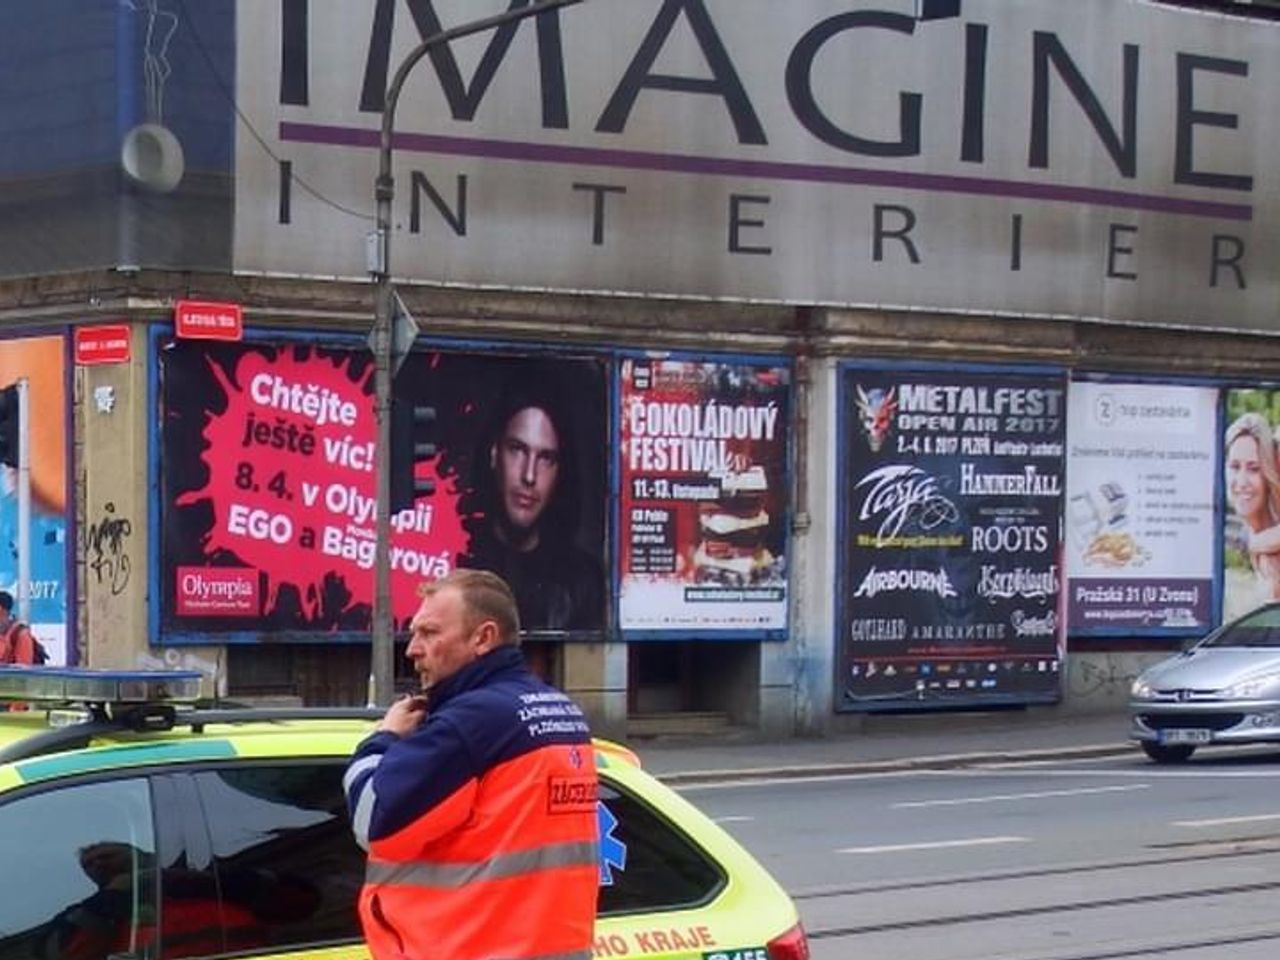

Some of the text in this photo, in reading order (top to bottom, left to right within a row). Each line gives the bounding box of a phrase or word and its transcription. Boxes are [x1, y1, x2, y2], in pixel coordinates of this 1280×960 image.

[279, 0, 1254, 192] IMAGINE
[279, 160, 1248, 290] INTERIER
[250, 373, 358, 426] Chtějte
[629, 395, 779, 441] ČOKOLÁDOVÝ
[898, 384, 1063, 417] METALFEST
[242, 412, 376, 471] ještě víc!
[898, 415, 1060, 434] OPEN AIR 2017
[629, 436, 729, 473] FESTIVAL
[235, 463, 260, 492] 8.
[267, 468, 293, 501] 4.
[301, 482, 320, 507] v
[227, 504, 451, 580] EGO a Bagrová
[972, 525, 1048, 552] ROOTS
[182, 574, 253, 600] Olympia
[853, 566, 958, 598] AIRBOURNE
[634, 925, 717, 953] KRAJE
